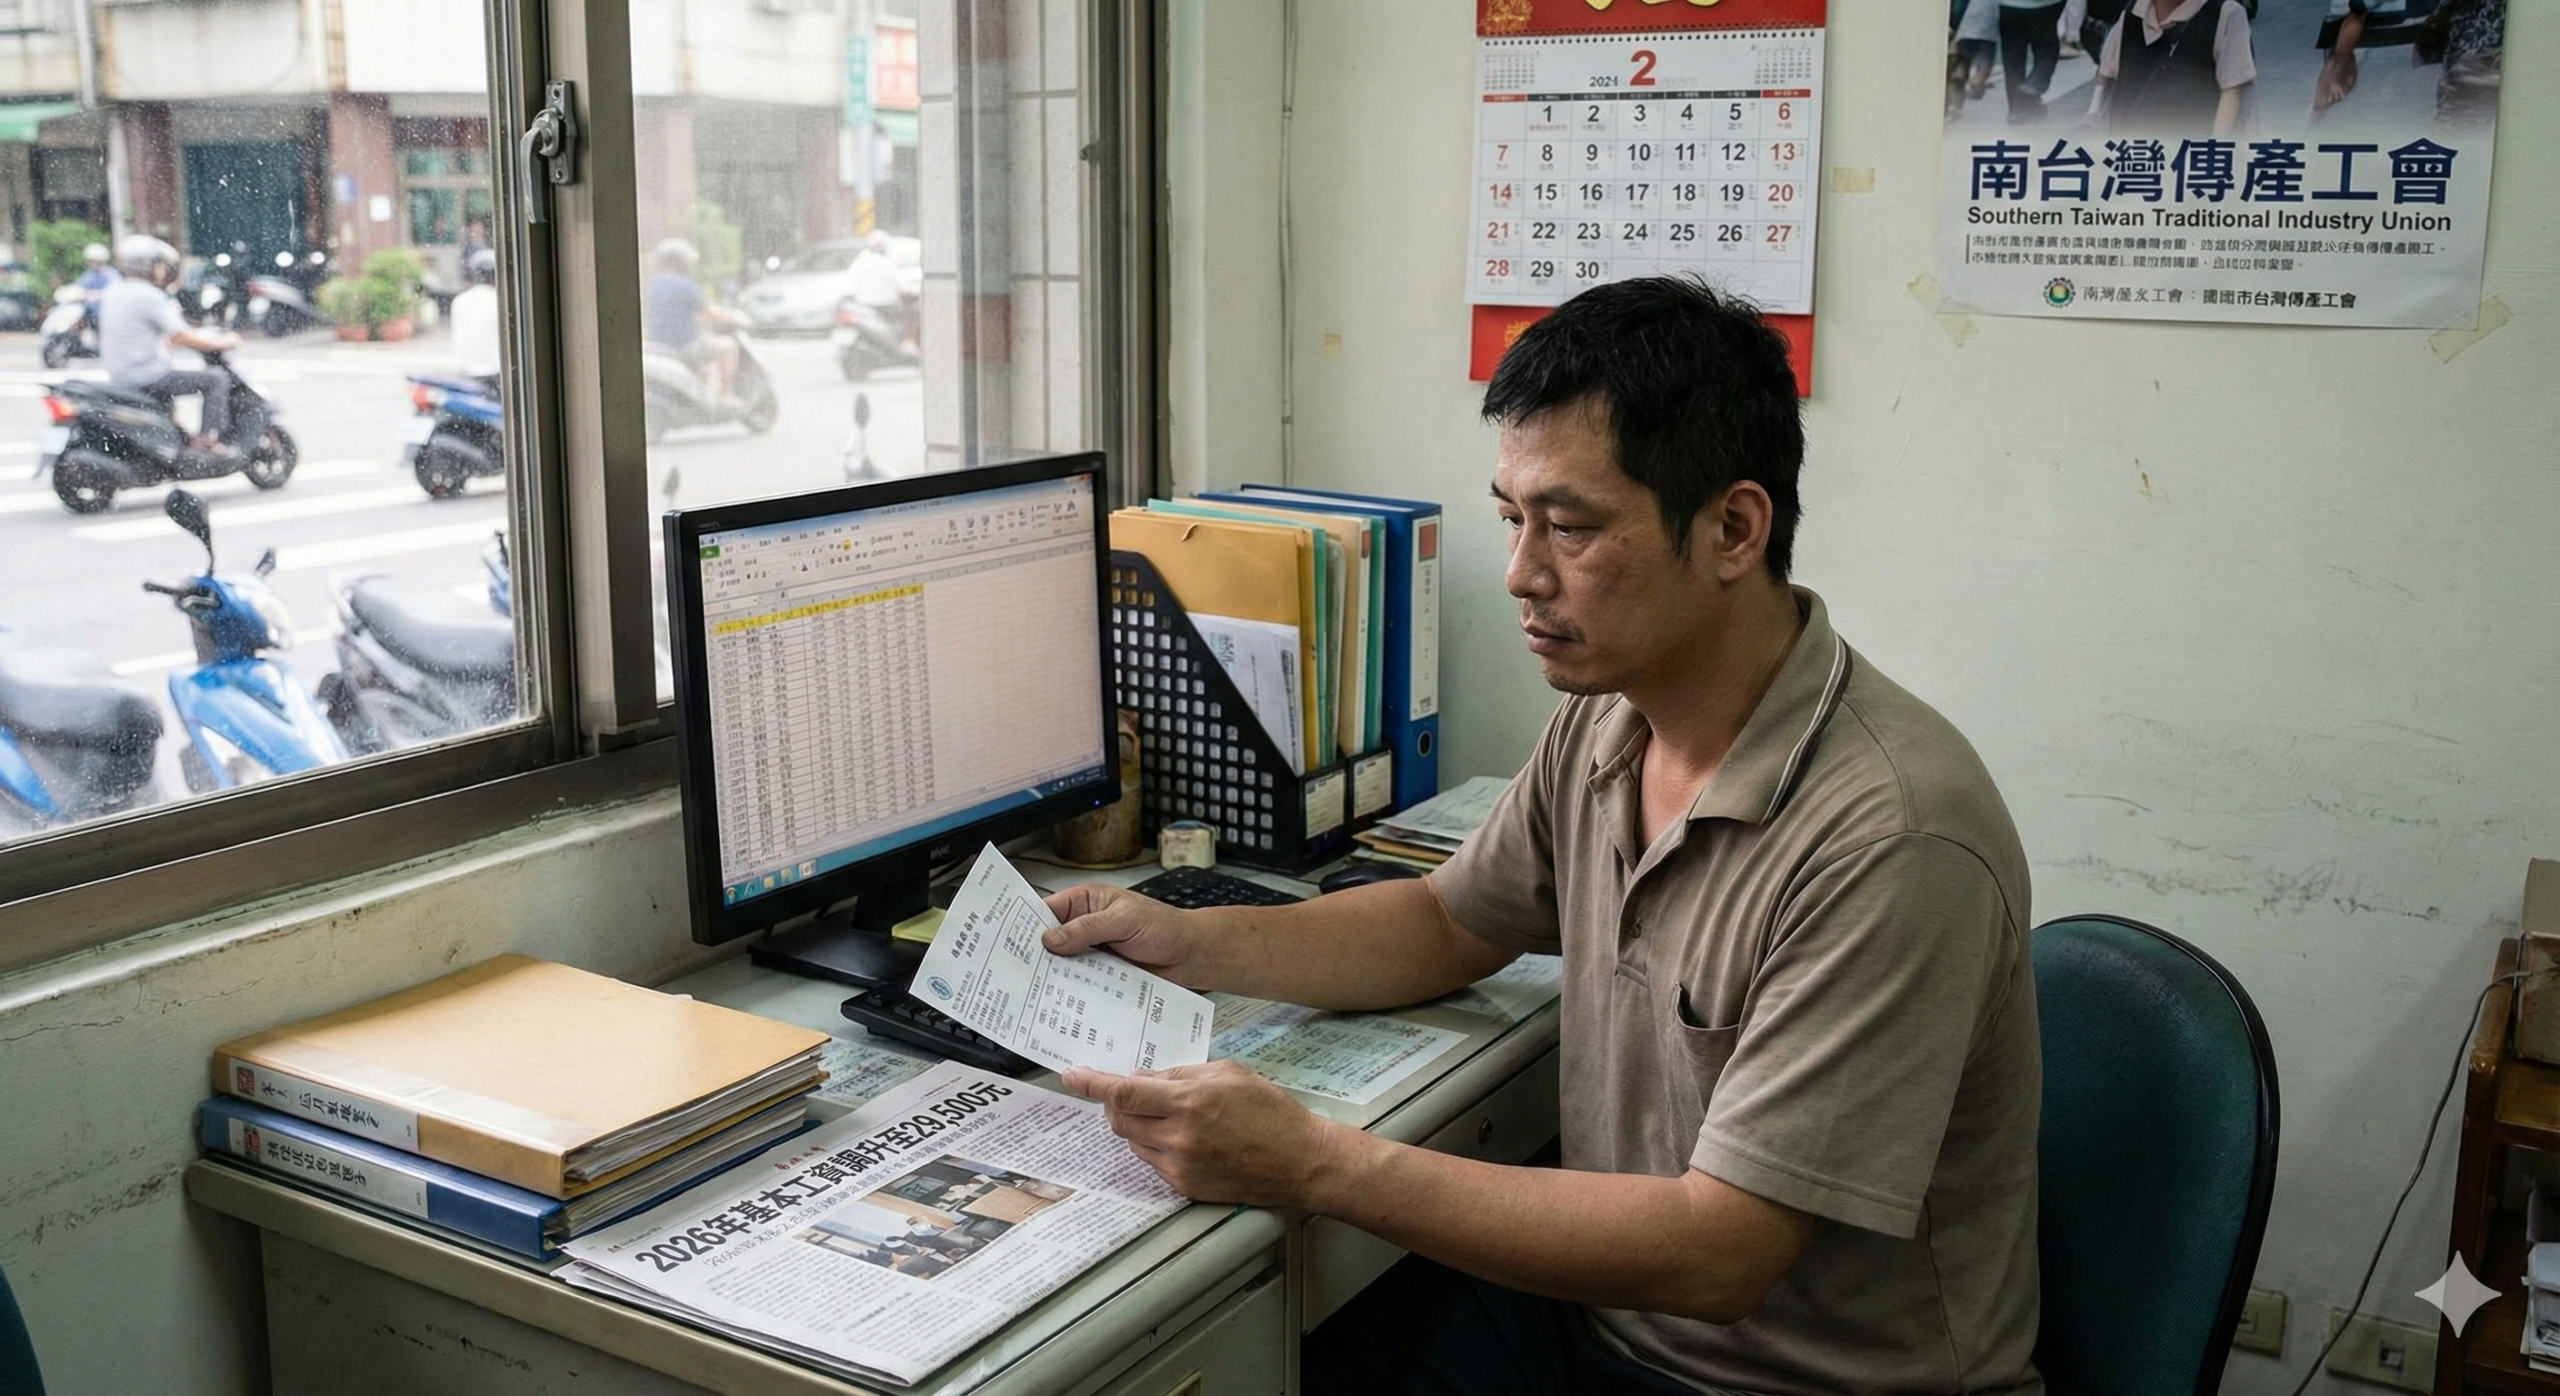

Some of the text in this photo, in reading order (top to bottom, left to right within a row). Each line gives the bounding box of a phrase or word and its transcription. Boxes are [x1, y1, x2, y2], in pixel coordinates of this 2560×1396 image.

[1629, 50, 1657, 87] 2
[1543, 103, 1791, 122] 1 2 3 4 5 6
[1497, 143, 1796, 162] 7 8 9 10 11 12 13
[1970, 137, 2459, 205] 南台灣傳產工會
[1489, 184, 1794, 202] 14 15 16 17 18 19 20
[1967, 206, 2452, 235] Southern Taiwan Traditional Industry Union
[1487, 222, 1792, 243] 21 22 23 24 25 26 27
[1485, 260, 1600, 279] 28 29 30
[635, 1081, 1013, 1273] 2026年基本工資調升至29,500元
